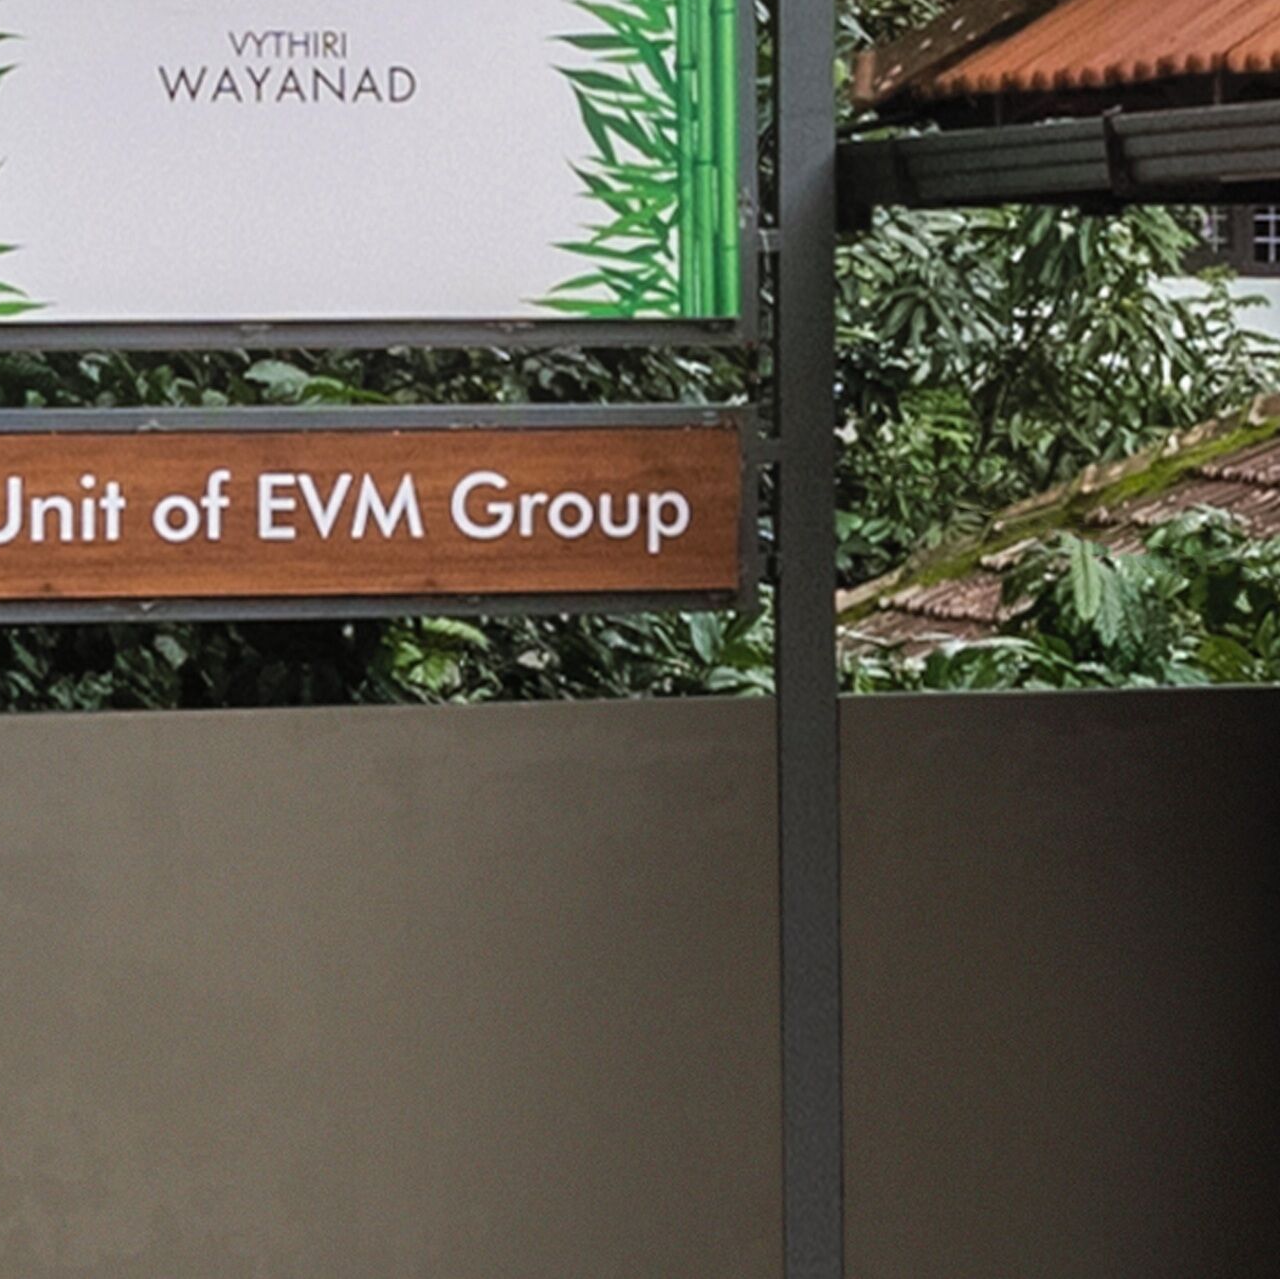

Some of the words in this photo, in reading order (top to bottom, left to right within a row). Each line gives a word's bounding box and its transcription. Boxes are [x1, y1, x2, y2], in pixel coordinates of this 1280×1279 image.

[228, 30, 348, 59] VYTHIRI
[158, 65, 417, 104] WAYANAD
[152, 469, 231, 542] of
[258, 473, 424, 540] EVM
[451, 470, 690, 554] Group
